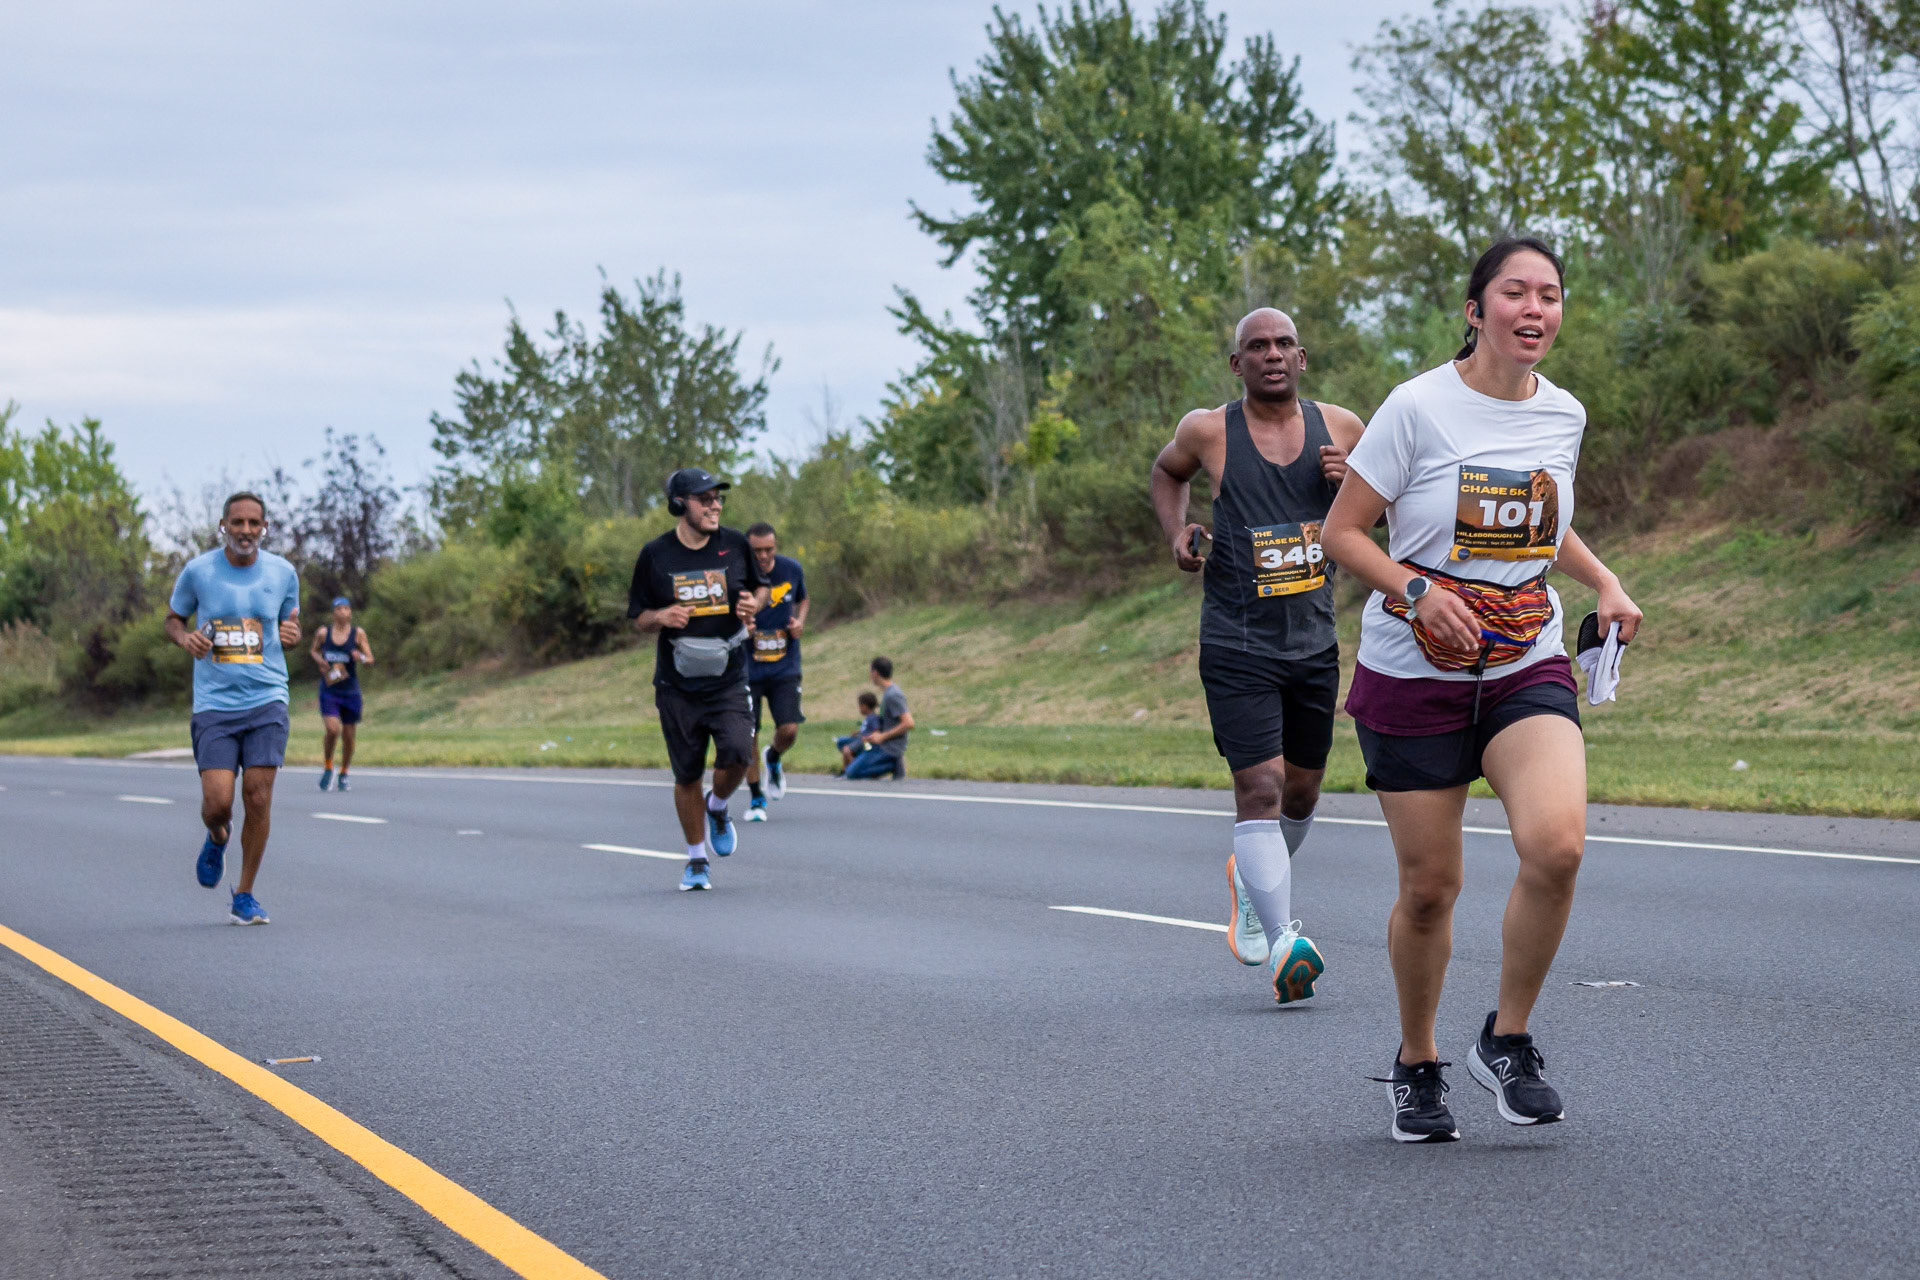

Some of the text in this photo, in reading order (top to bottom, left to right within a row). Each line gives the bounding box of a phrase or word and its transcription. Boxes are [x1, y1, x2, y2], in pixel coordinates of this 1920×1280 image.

[1461, 472, 1489, 481] THE
[1460, 485, 1528, 496] CHASE 5K
[1479, 499, 1544, 527] 101
[1253, 530, 1273, 538] THE
[1254, 538, 1288, 547] CHASE
[1260, 543, 1323, 569] 346
[678, 583, 723, 601] 364
[214, 631, 260, 646] 256
